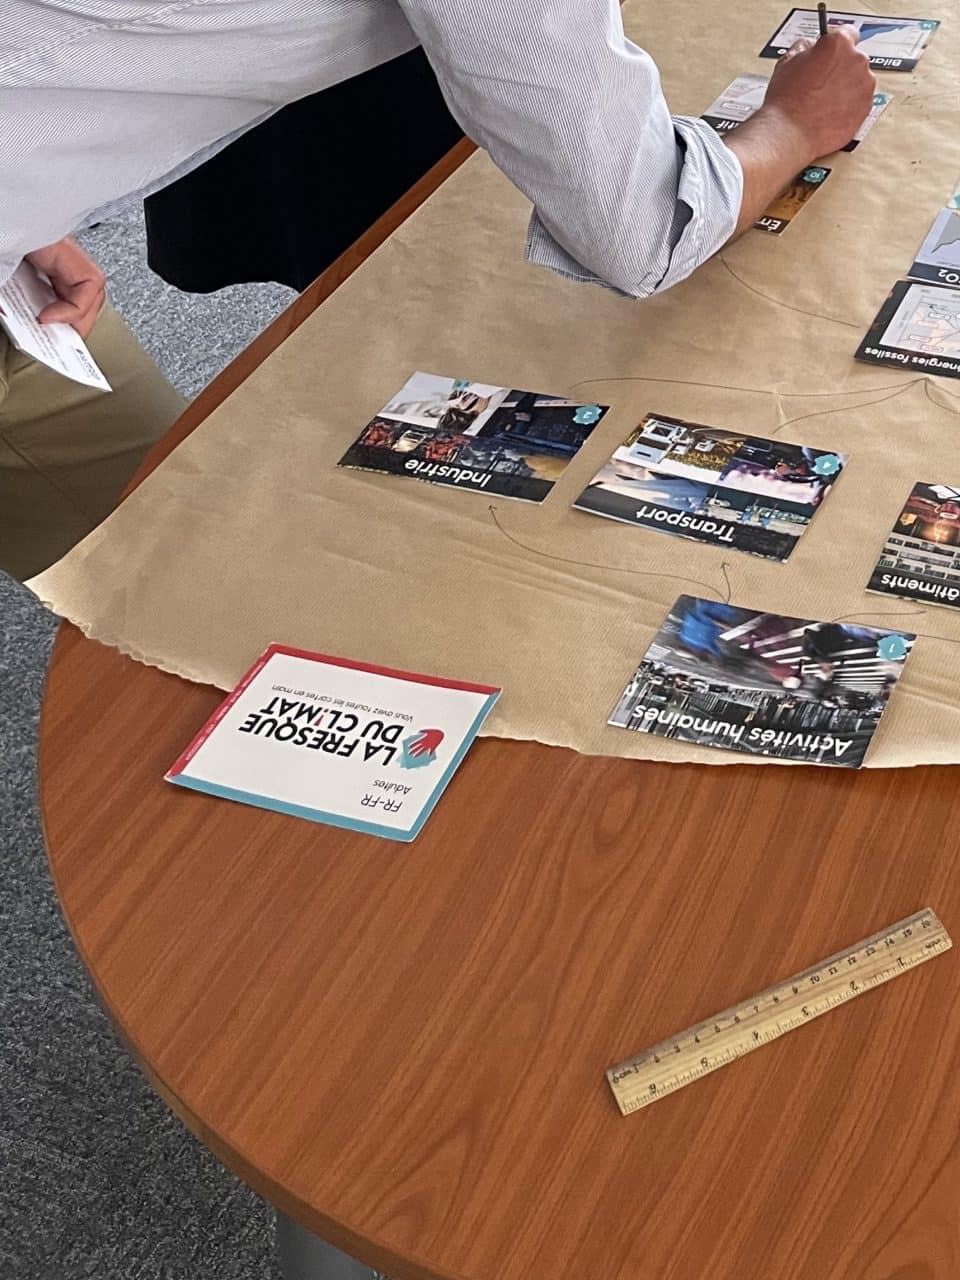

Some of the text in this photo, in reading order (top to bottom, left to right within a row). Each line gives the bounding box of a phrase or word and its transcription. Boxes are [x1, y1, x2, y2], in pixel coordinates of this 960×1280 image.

[864, 346, 909, 364] fossiles
[404, 458, 492, 488] Industrie
[634, 505, 736, 542] Transport
[272, 685, 414, 724] Vous avez toutes les cartes en main
[238, 713, 360, 758] FRESQUE
[360, 720, 404, 744] DU
[632, 704, 854, 757] Activités humaines
[363, 741, 398, 766] LA
[373, 780, 412, 795] Adultes
[360, 794, 403, 813] FR-FR
[810, 974, 820, 984] 10
[884, 938, 895, 947] 14
